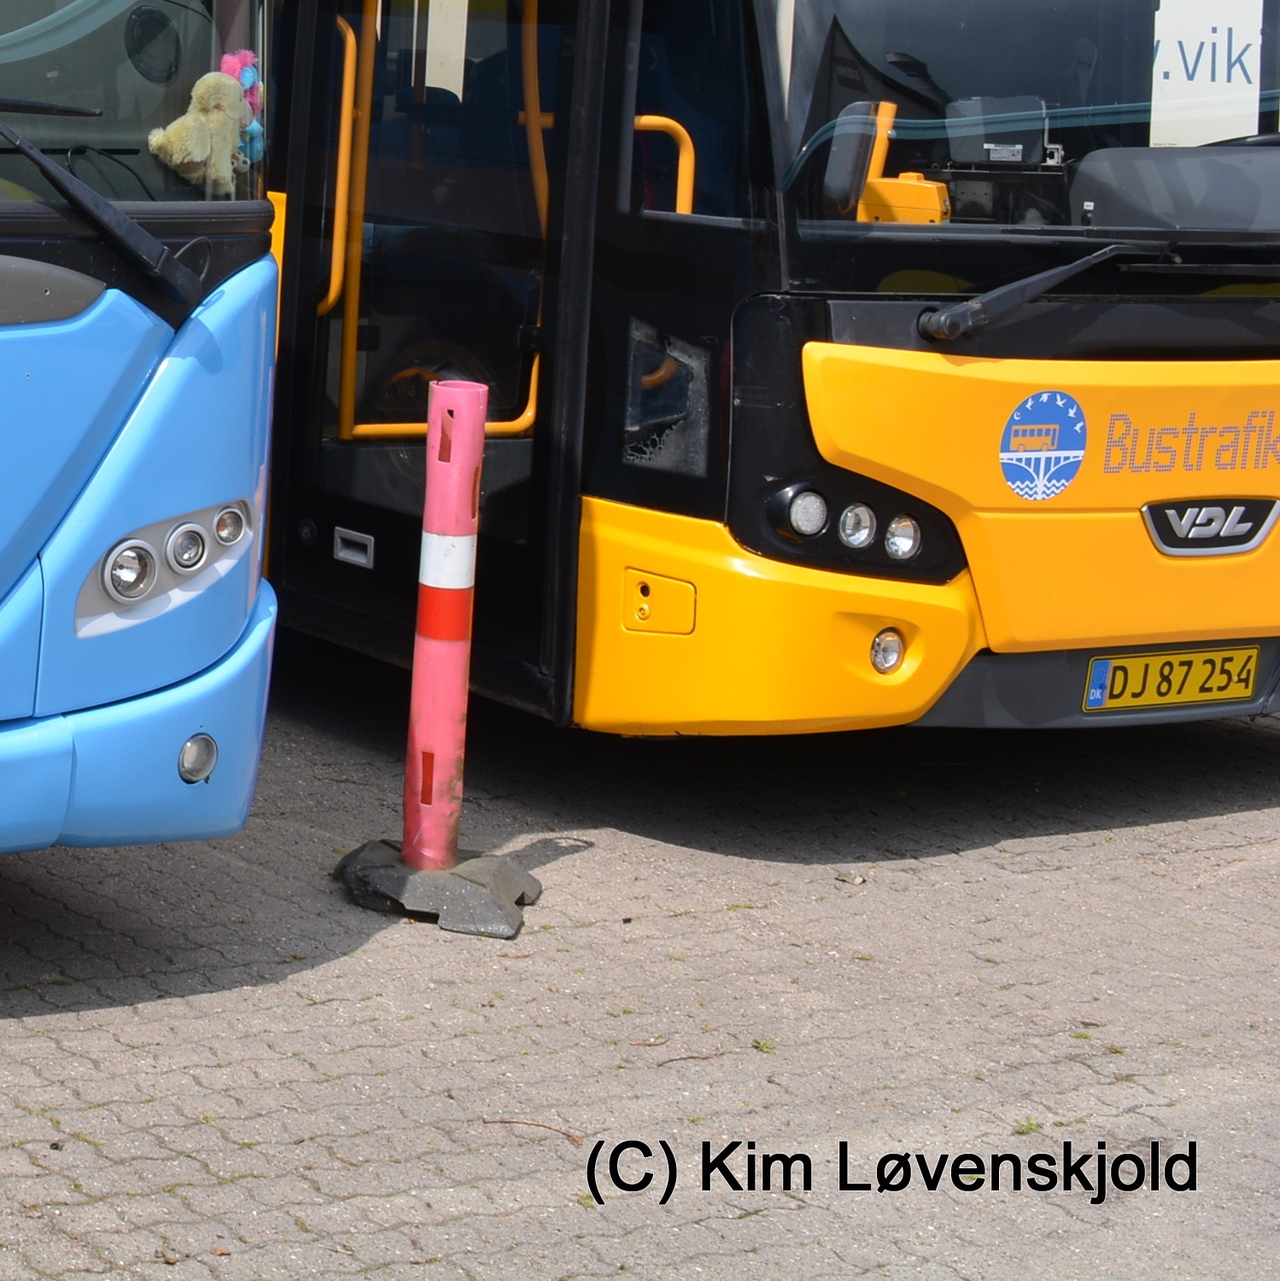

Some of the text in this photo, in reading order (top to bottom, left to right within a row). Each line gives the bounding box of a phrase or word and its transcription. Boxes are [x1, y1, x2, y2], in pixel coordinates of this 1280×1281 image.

[1153, 25, 1253, 85] .vik
[1164, 506, 1253, 539] VDL
[1089, 688, 1102, 700] DK
[1108, 655, 1253, 700] DJ 87 254
